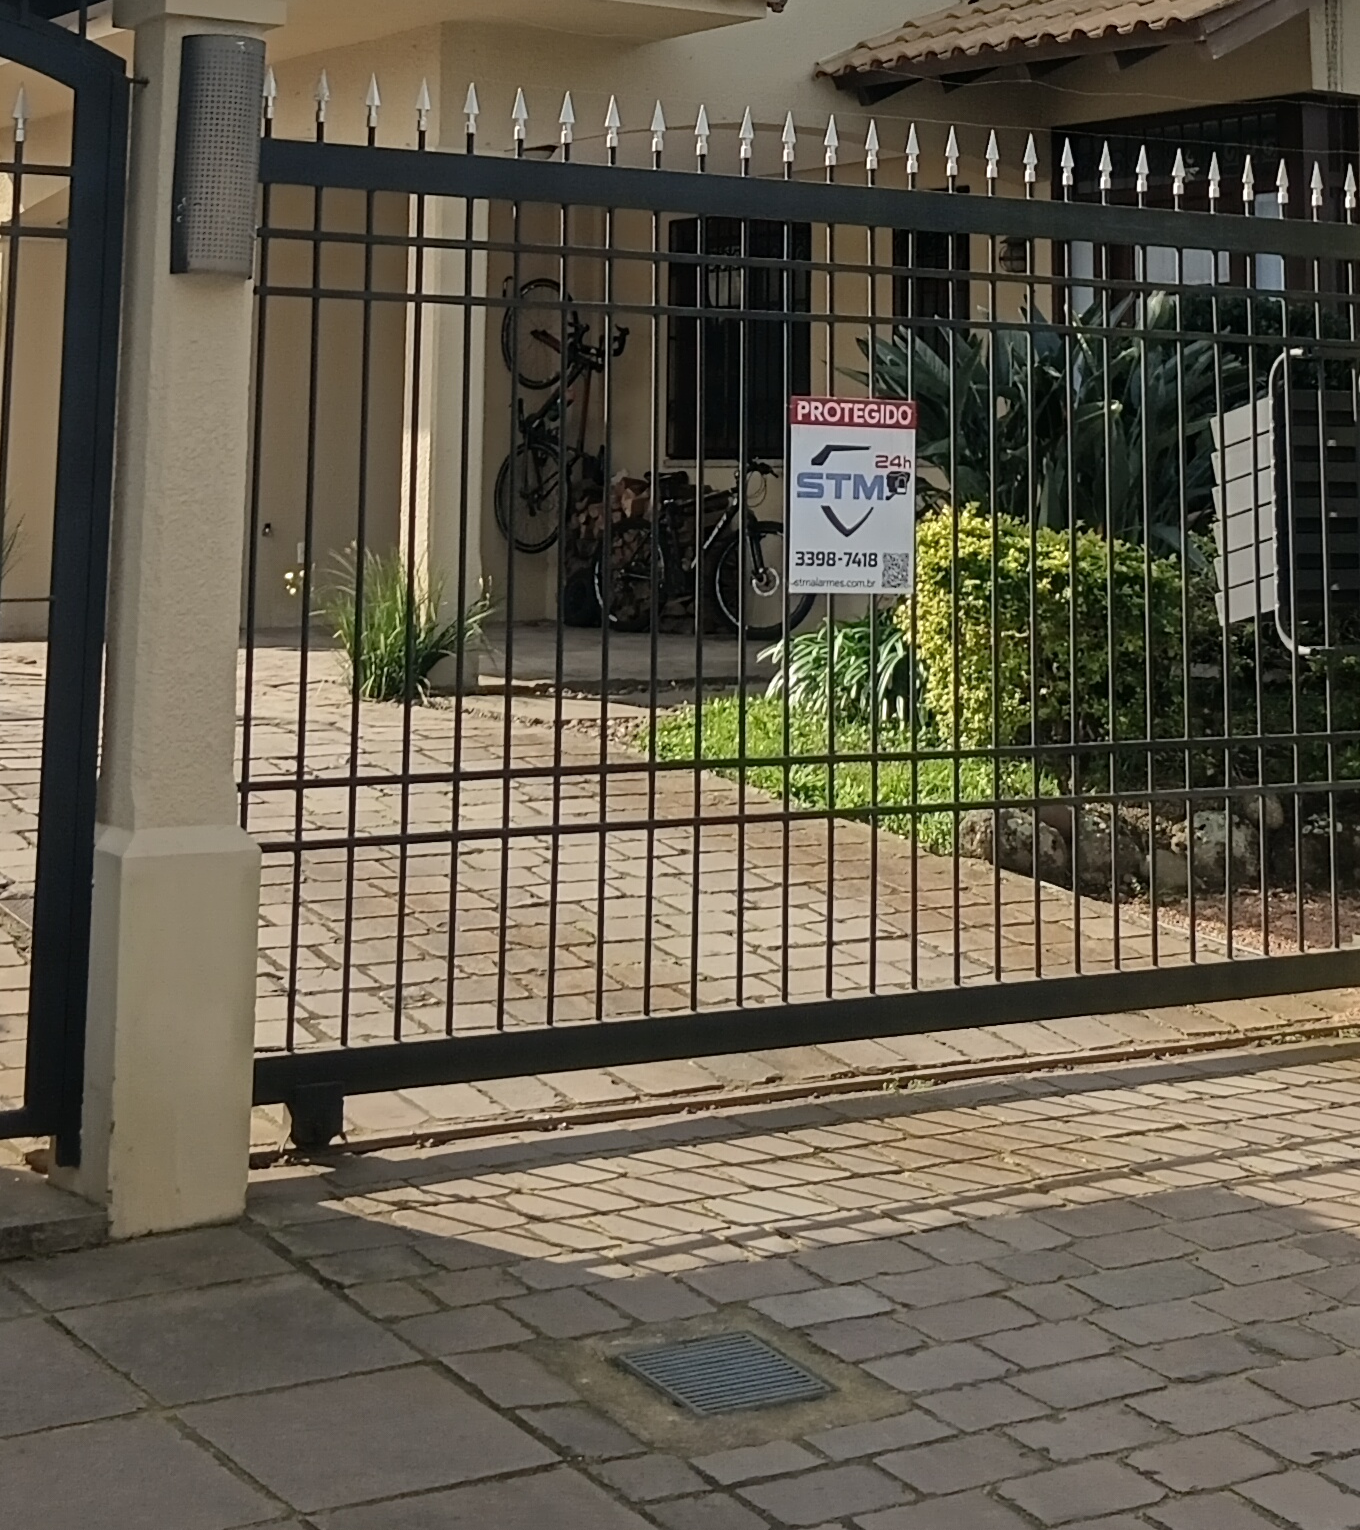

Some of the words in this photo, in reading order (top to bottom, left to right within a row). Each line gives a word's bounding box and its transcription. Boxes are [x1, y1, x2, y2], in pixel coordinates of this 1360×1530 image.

[796, 400, 913, 426] PROTEGIDO
[875, 454, 912, 470] 24h
[796, 472, 885, 501] STM
[795, 551, 879, 568] 3398-7418
